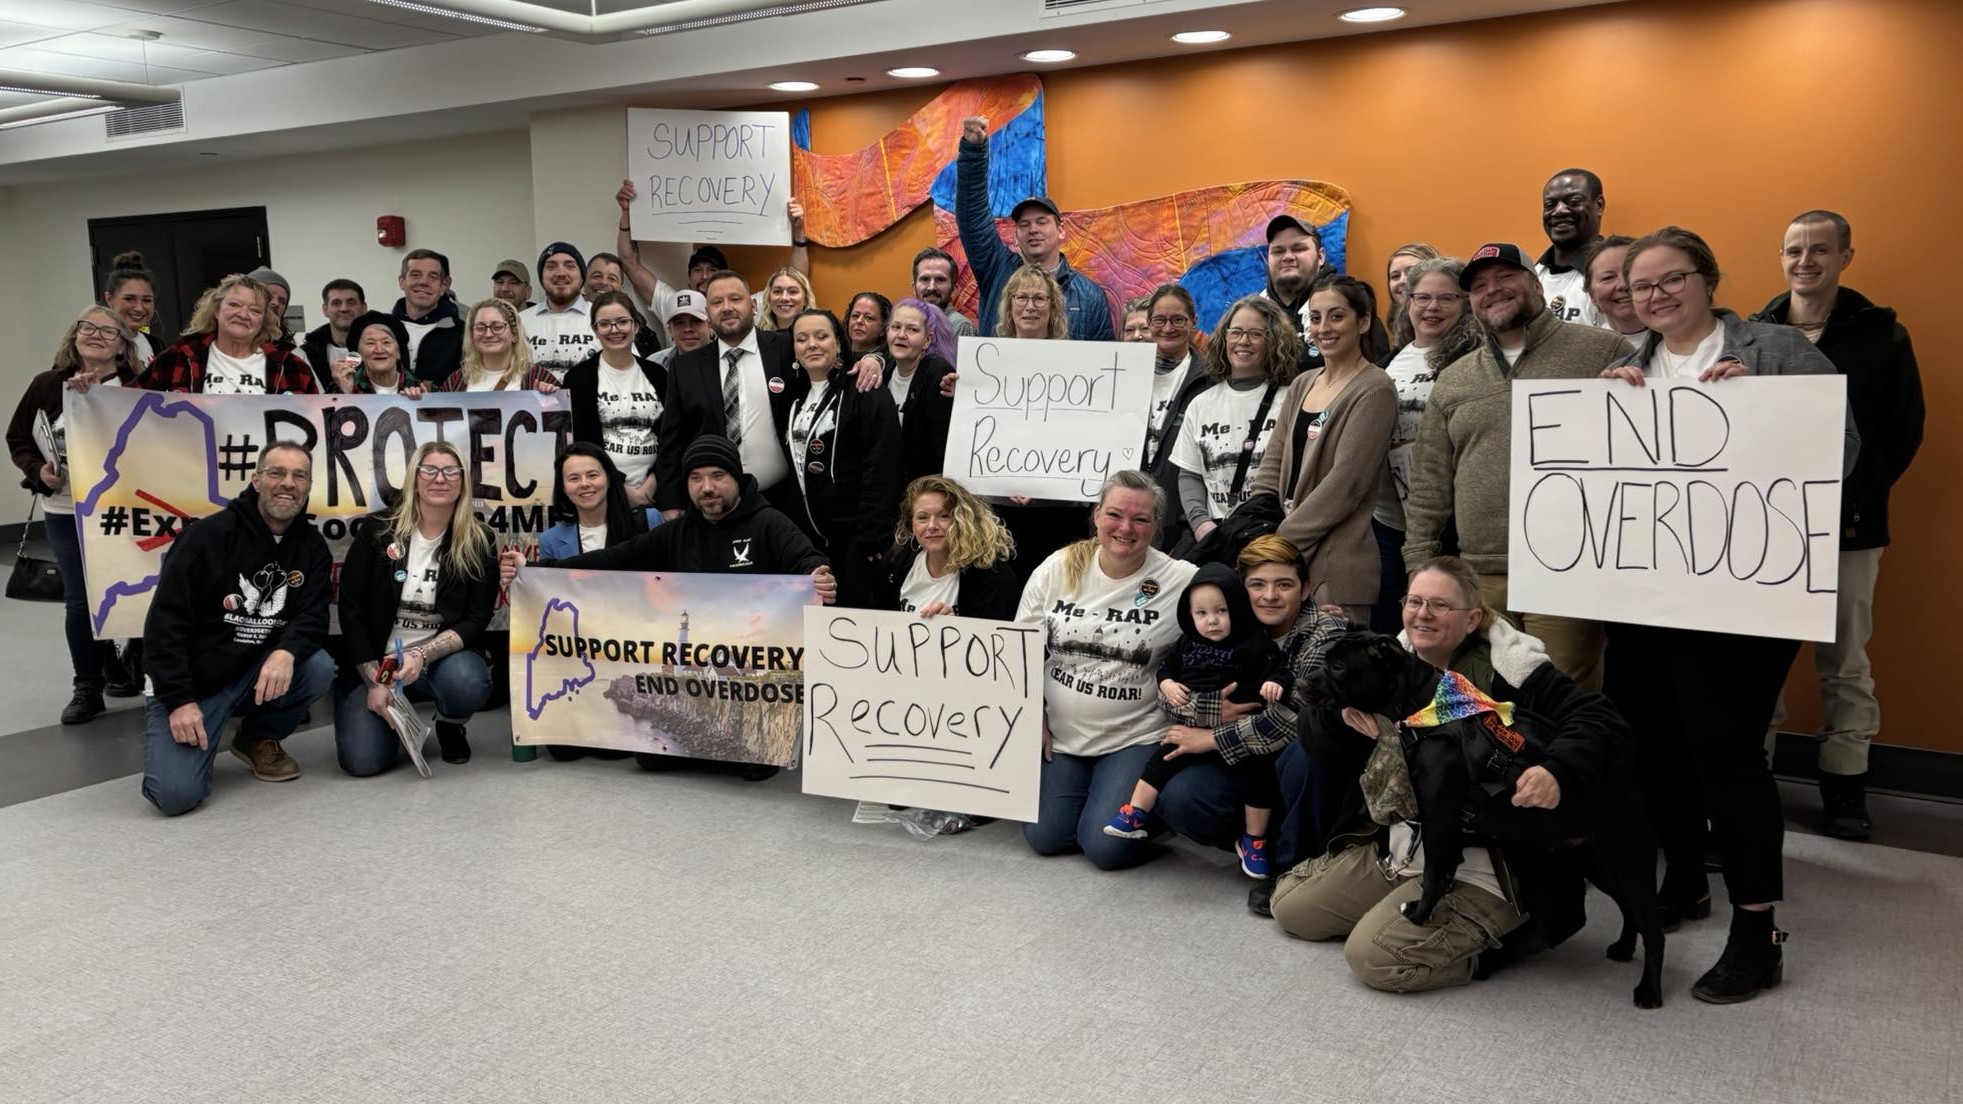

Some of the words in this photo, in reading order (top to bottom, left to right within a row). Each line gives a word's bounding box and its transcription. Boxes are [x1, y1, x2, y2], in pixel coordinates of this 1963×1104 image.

[647, 122, 776, 162] SUPPORT
[649, 172, 776, 216] RECOVERY
[1554, 307, 1581, 321] AP
[558, 334, 594, 345] RAP
[631, 391, 660, 402] RA
[974, 342, 1127, 423] Support
[1200, 421, 1231, 438] Me
[1528, 386, 1730, 468] END
[603, 440, 624, 455] EAR
[627, 444, 640, 456] US
[969, 414, 1112, 498] Recovery
[1523, 471, 1841, 593] OVERDOSE
[1052, 599, 1086, 618] Me
[1105, 607, 1160, 626] RAP
[544, 633, 655, 665] SUPPORT
[661, 641, 805, 671] RECOVERY
[818, 616, 1040, 699] SUPPORT
[635, 674, 680, 698] END
[684, 677, 805, 705] OVERDOSE
[1075, 678, 1095, 696] US
[1096, 684, 1143, 701] ROAR!
